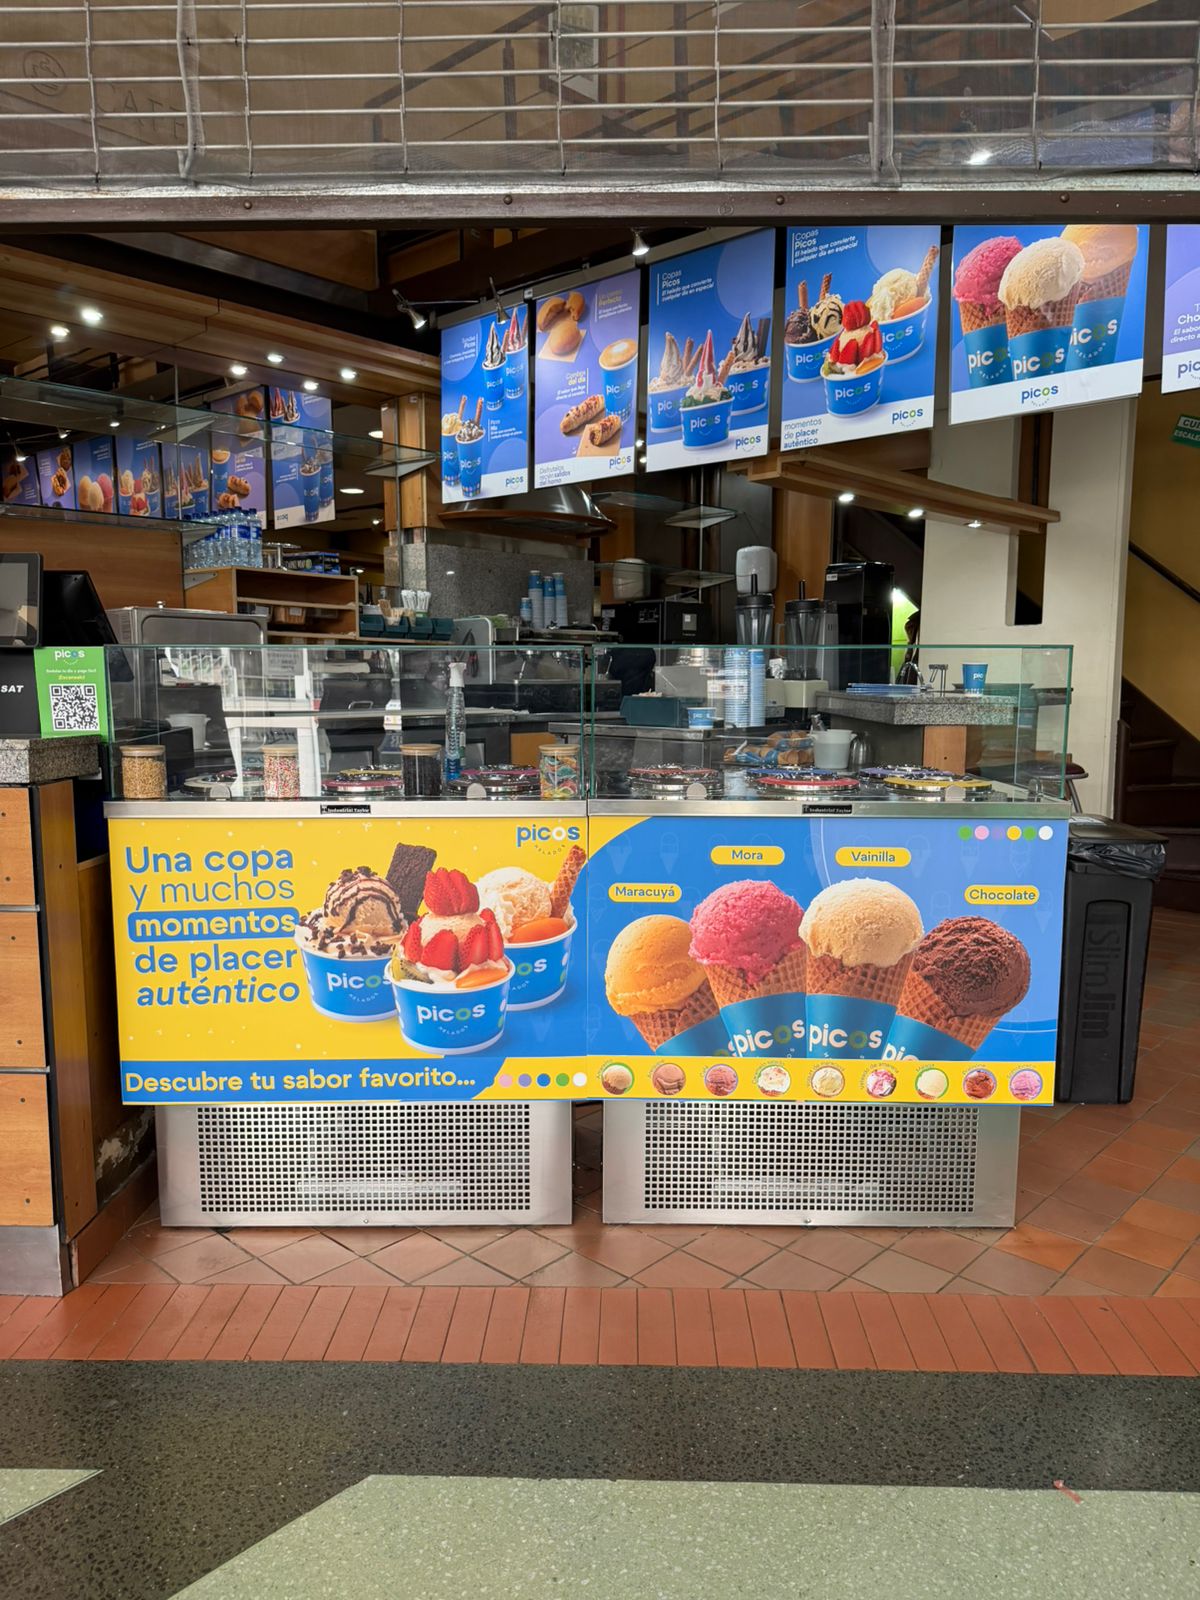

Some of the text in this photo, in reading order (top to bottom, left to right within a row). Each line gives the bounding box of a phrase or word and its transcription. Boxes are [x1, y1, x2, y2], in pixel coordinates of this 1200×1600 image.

[795, 229, 820, 241] Copas
[794, 238, 817, 250] Picos
[662, 279, 680, 288] Picos
[882, 325, 914, 343] icos
[1070, 319, 1118, 346] icos
[968, 350, 1010, 374] pico
[1013, 347, 1065, 382] picos
[606, 379, 632, 395] picos
[835, 382, 872, 401] picos
[1021, 385, 1060, 404] picos
[690, 415, 722, 432] picos
[784, 418, 822, 431] momentos
[891, 408, 924, 424] picos
[735, 435, 762, 450] picos
[784, 428, 819, 440] de placer
[783, 437, 819, 449] auténtico
[608, 455, 632, 469] picos
[505, 476, 524, 488] picos
[54, 650, 86, 662] picos
[516, 824, 580, 848] picos
[126, 846, 294, 878] Una copa
[731, 849, 764, 861] Mora
[851, 850, 896, 863] Vainilla
[129, 873, 295, 911] y muchos
[615, 886, 675, 900] Maracuyá
[969, 889, 1036, 901] Chocolate
[135, 911, 296, 937] momentos
[134, 943, 298, 979] de placer
[137, 976, 300, 1007] auténtico
[416, 1004, 486, 1024] picos
[733, 1019, 805, 1058] picos
[808, 1023, 883, 1052] picos
[125, 1066, 476, 1092] Descubre tu sabor favorito...
